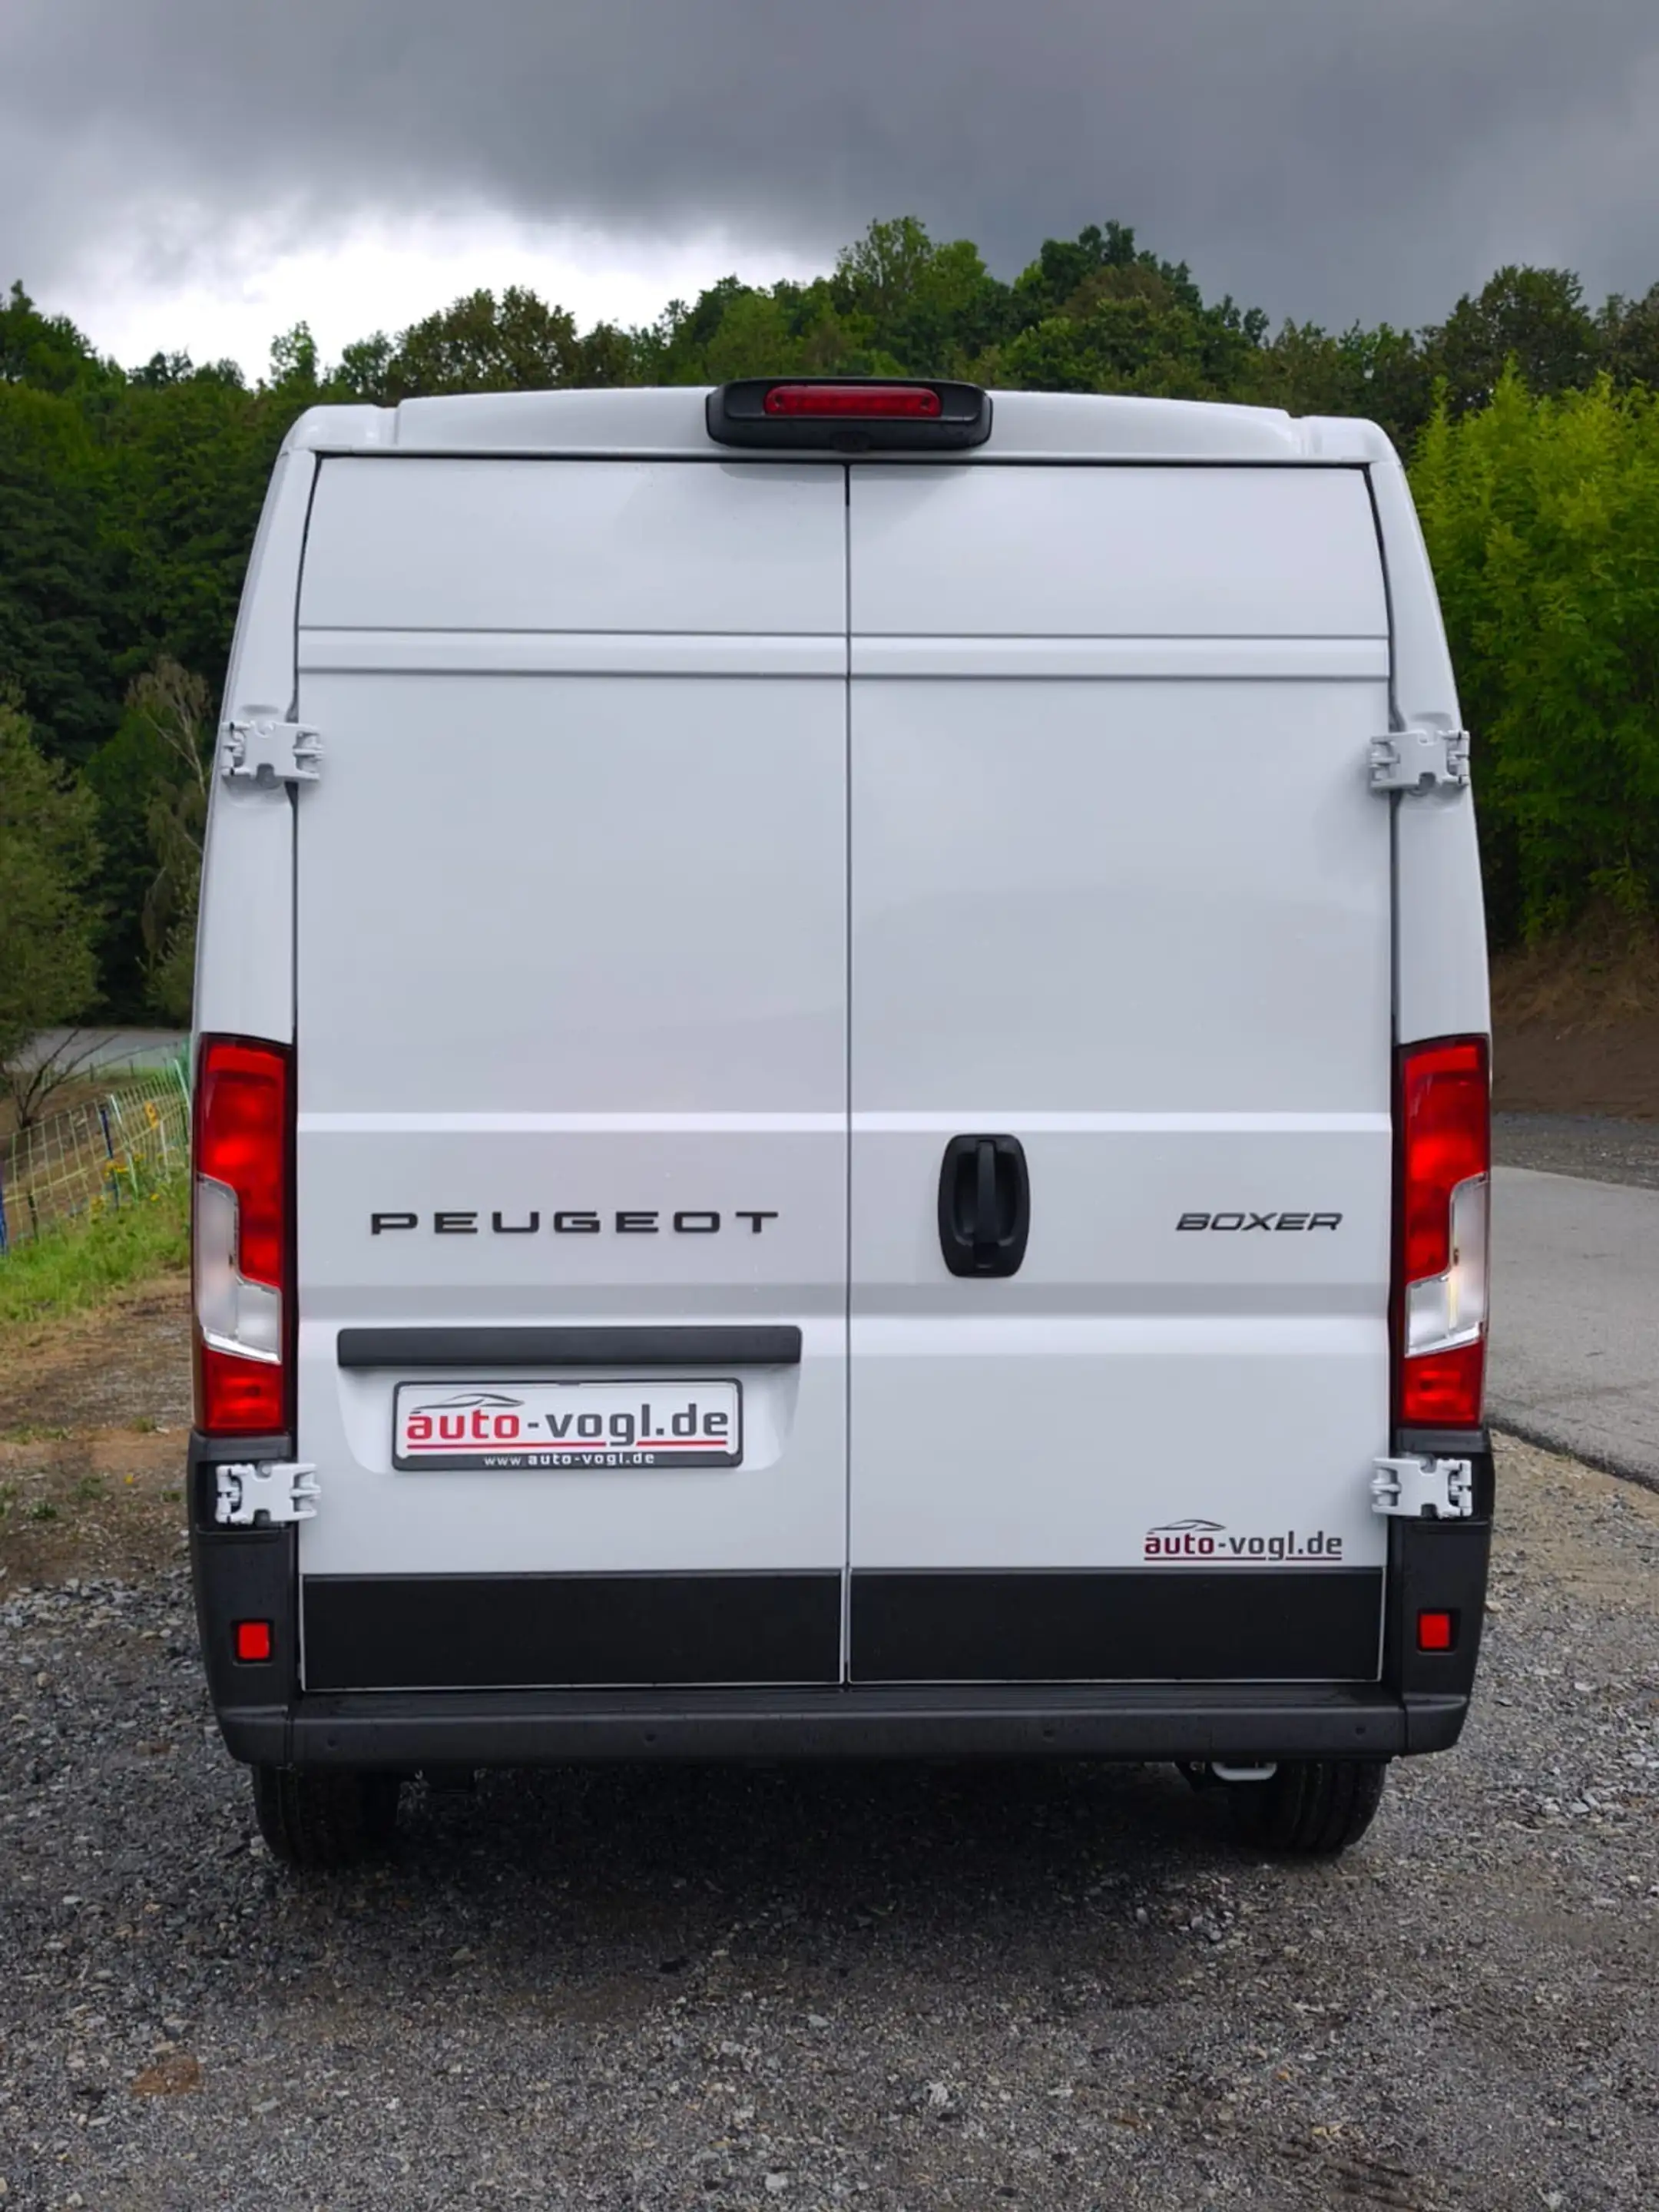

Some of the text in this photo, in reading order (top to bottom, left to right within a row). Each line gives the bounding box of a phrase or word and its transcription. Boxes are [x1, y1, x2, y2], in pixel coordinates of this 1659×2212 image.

[370, 1211, 778, 1235] PEUGEOT
[1175, 1213, 1343, 1231] BOXER
[406, 1403, 729, 1446] auto-vogl.de
[1144, 1531, 1343, 1561] auto-vogl.de
